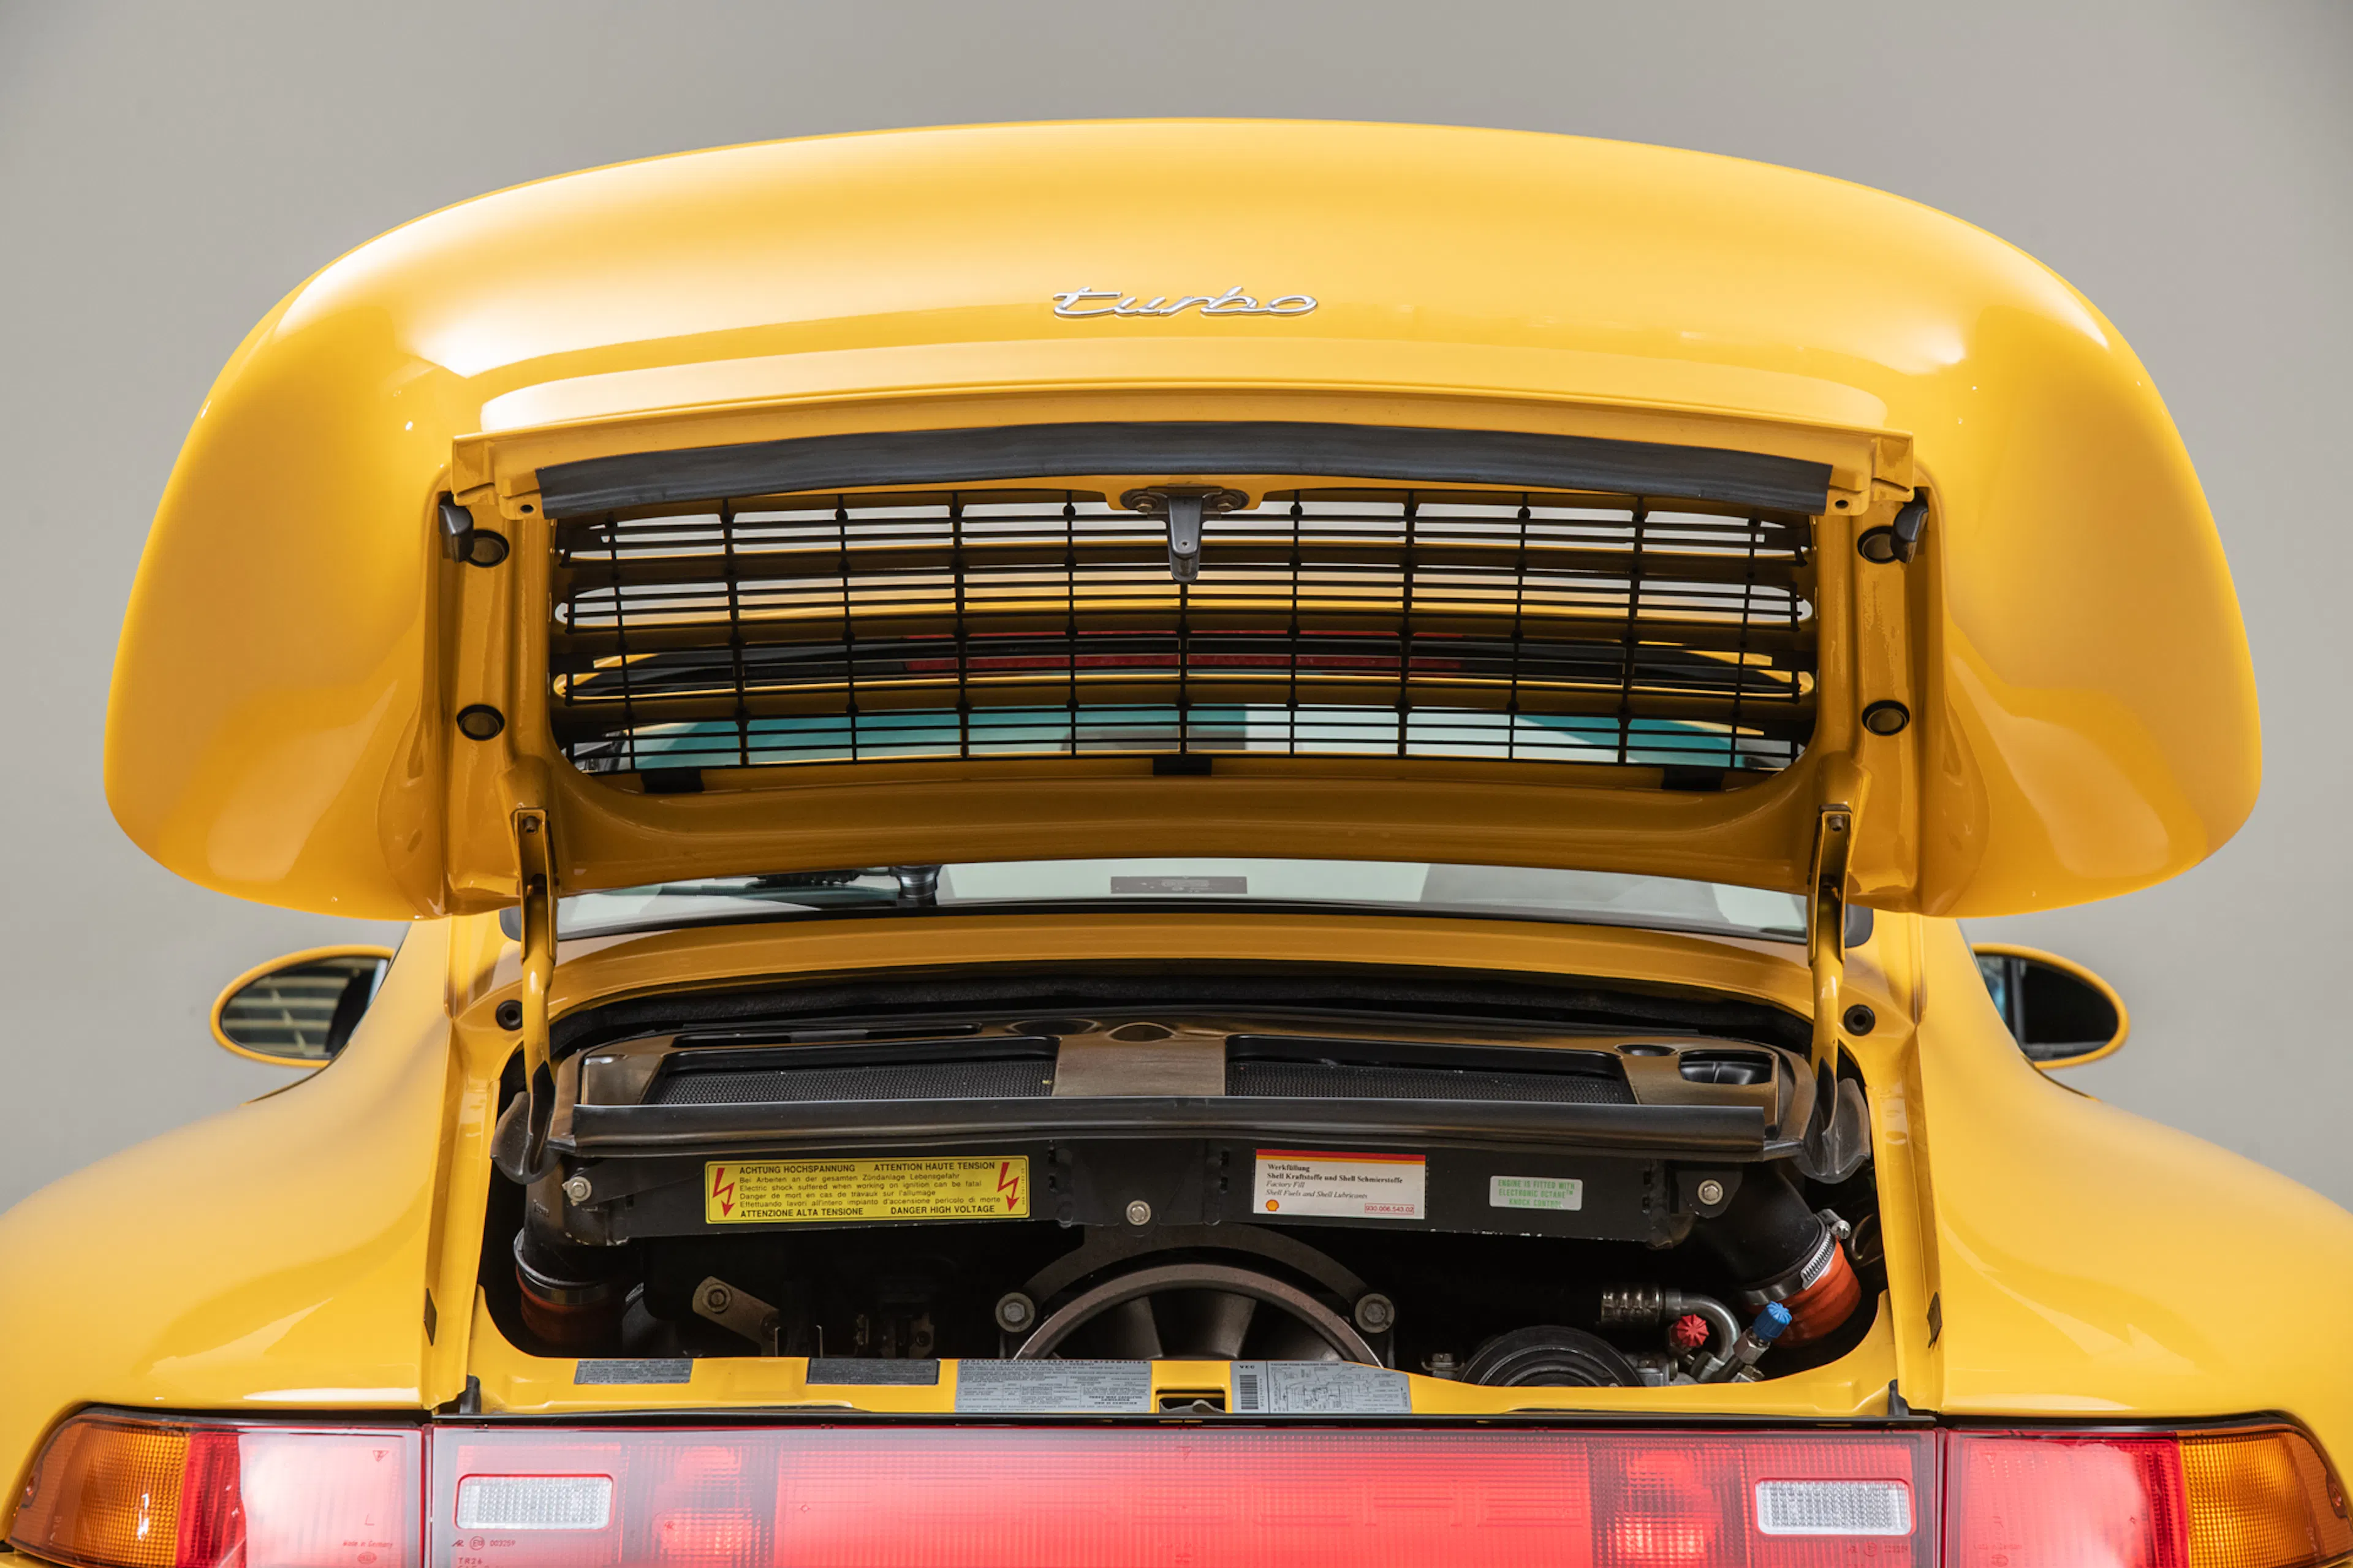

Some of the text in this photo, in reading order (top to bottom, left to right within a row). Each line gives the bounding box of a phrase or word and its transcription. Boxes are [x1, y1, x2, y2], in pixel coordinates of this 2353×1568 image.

[1053, 286, 1318, 318] turbo
[740, 1164, 855, 1175] ACHTUNG HOCHSPANNUNG
[874, 1163, 923, 1172] ATTENTION
[1267, 1164, 1310, 1172] Werkfüllung
[1357, 1175, 1403, 1184] Schmierstoffe
[1498, 1179, 1521, 1187] ENGINE
[1498, 1189, 1539, 1197] ELECTRONIC
[740, 1209, 794, 1218] ATTENZIONE
